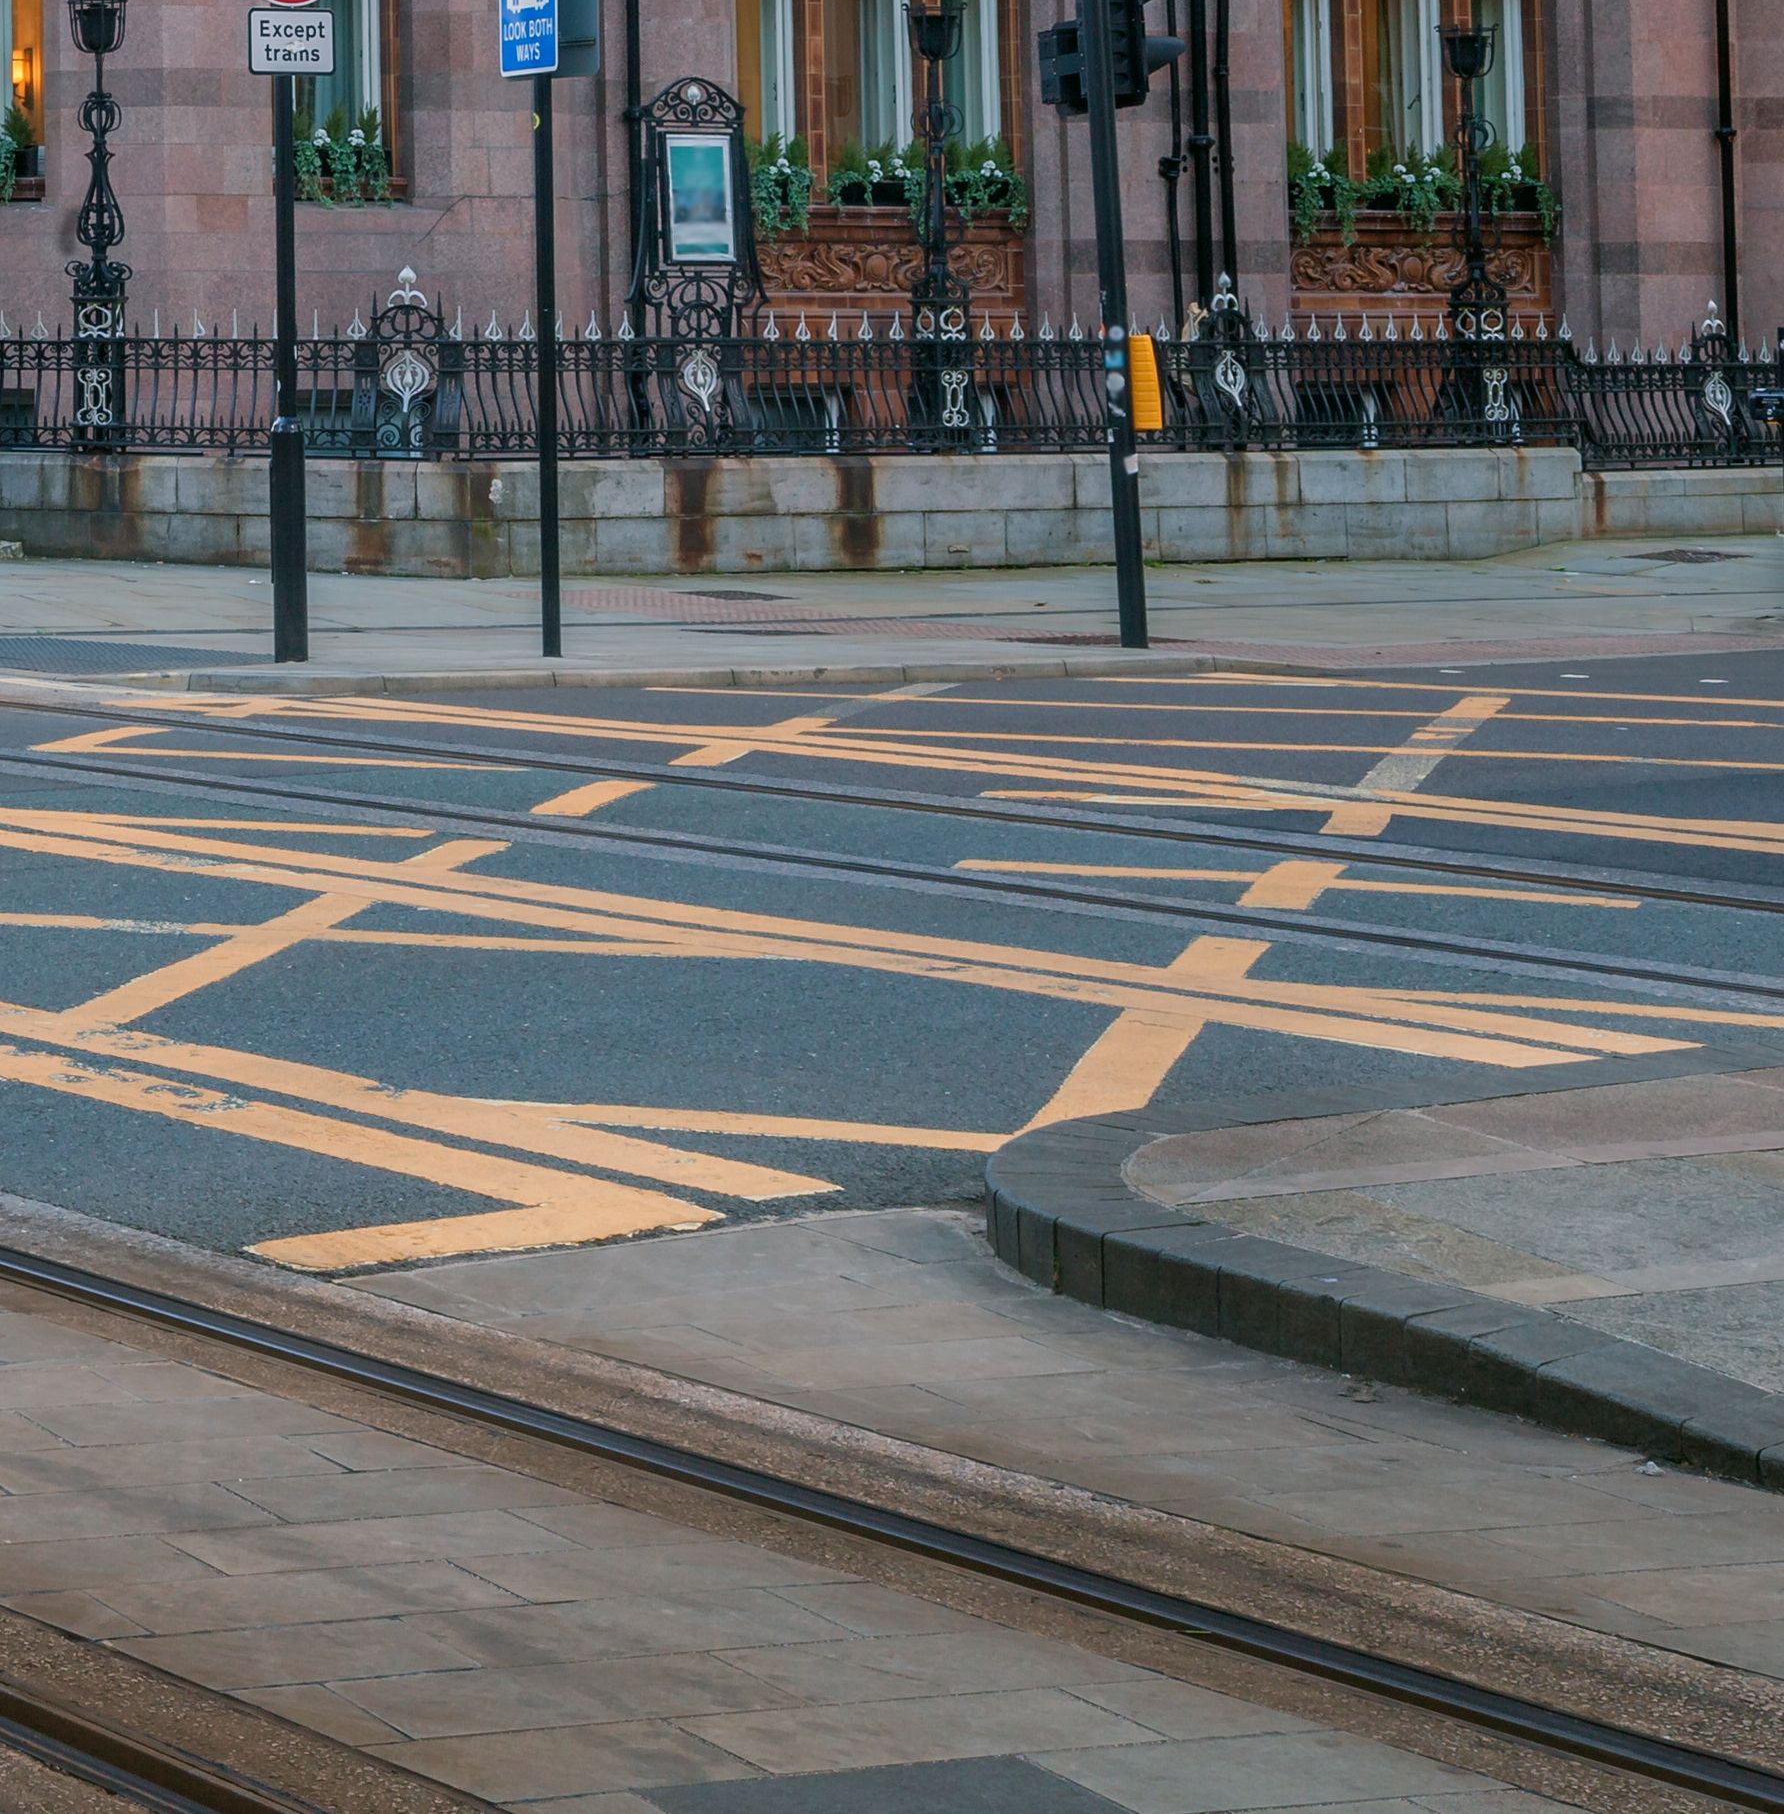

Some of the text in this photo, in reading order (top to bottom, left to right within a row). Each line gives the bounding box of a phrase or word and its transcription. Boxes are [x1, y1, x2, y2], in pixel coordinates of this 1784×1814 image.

[259, 19, 326, 41] Except
[503, 18, 553, 41] LOOK BOTH
[264, 44, 320, 62] trams
[515, 42, 541, 62] WAYS
